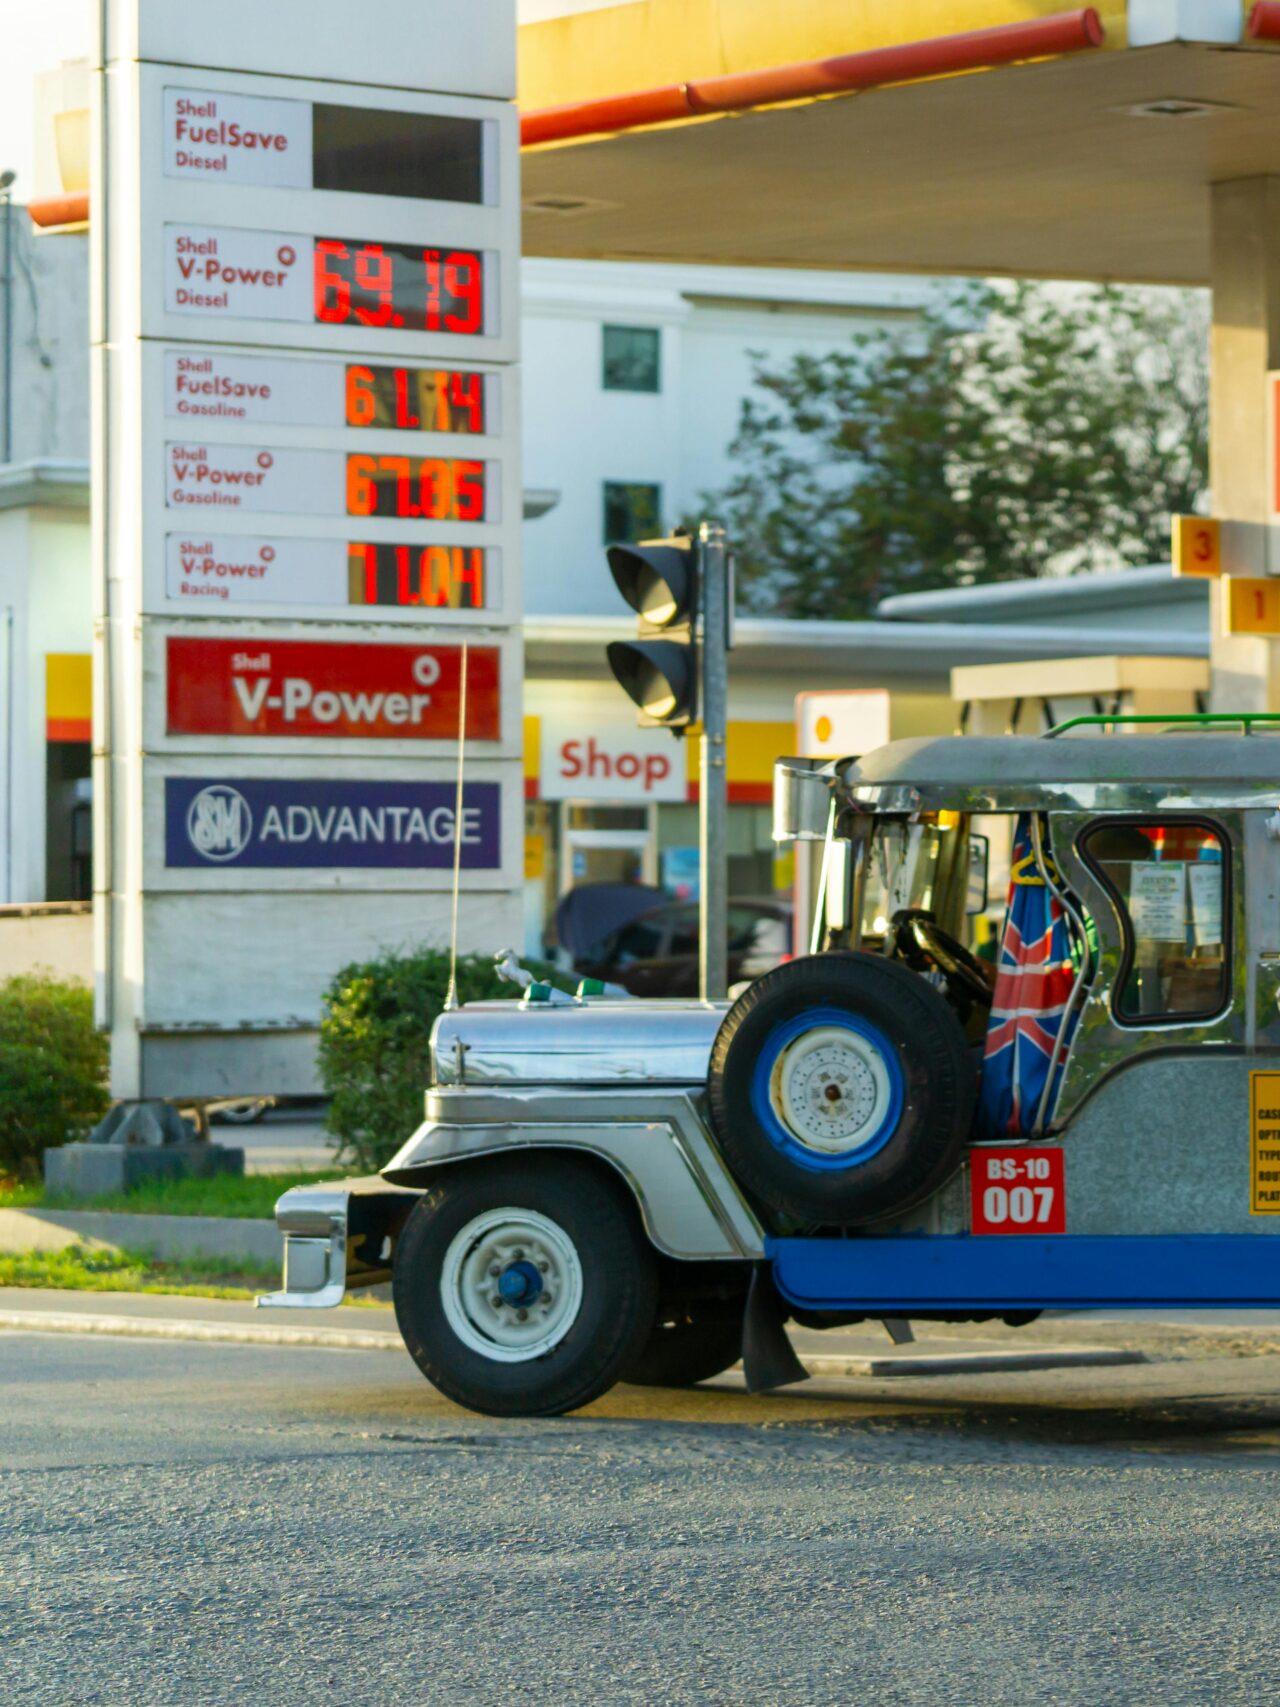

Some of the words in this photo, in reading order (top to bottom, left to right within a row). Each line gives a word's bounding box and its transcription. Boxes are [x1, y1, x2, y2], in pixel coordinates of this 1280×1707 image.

[176, 99, 217, 119] Shell
[175, 118, 288, 152] FuelSave
[175, 151, 227, 172] Diesel
[176, 236, 218, 256] Shell
[177, 257, 288, 288] V-Power
[176, 288, 229, 308] Diesel
[314, 239, 481, 335] 69.19
[177, 357, 213, 374] Shell
[176, 375, 271, 400] FuelSave
[177, 399, 246, 420] Gasoline
[172, 446, 208, 463] Shell
[173, 464, 266, 487] V-Power
[172, 488, 241, 508] Gasoline
[179, 541, 214, 558] Shell
[1194, 531, 1213, 562] 3
[181, 558, 267, 580] V-Power
[180, 581, 230, 601] Racing
[1252, 590, 1266, 621] 1
[232, 651, 270, 671] Shell
[232, 677, 431, 725] V-Power
[559, 740, 671, 790] Shop
[259, 804, 482, 845] ADVANTAGE
[987, 1158, 1050, 1180] BS-10
[983, 1186, 1054, 1223] 007
